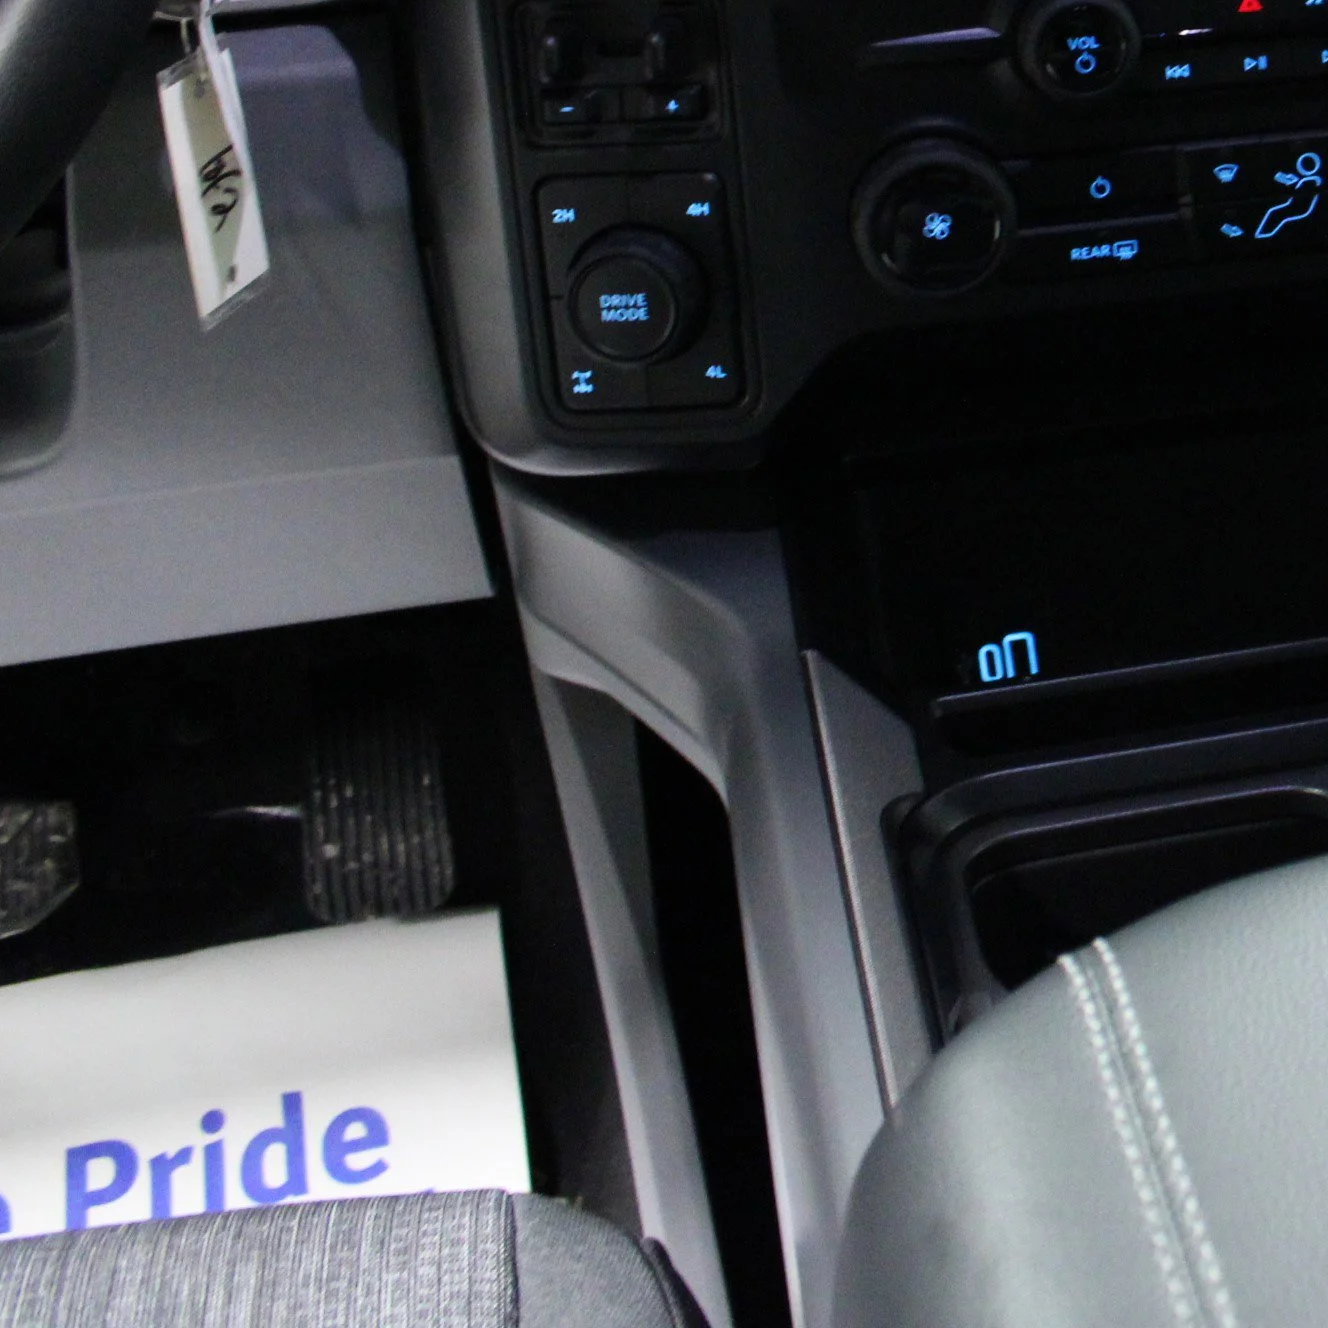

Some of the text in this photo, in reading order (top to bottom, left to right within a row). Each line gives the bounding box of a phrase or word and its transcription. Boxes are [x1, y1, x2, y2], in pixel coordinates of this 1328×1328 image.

[1067, 36, 1101, 51] VOL
[551, 208, 576, 223] 2H
[685, 202, 711, 217] 4H
[1070, 244, 1112, 260] REAR
[599, 293, 649, 309] DRIVE
[600, 307, 650, 322] MODE
[705, 365, 728, 379] 4L
[65, 1090, 391, 1230] Pride
